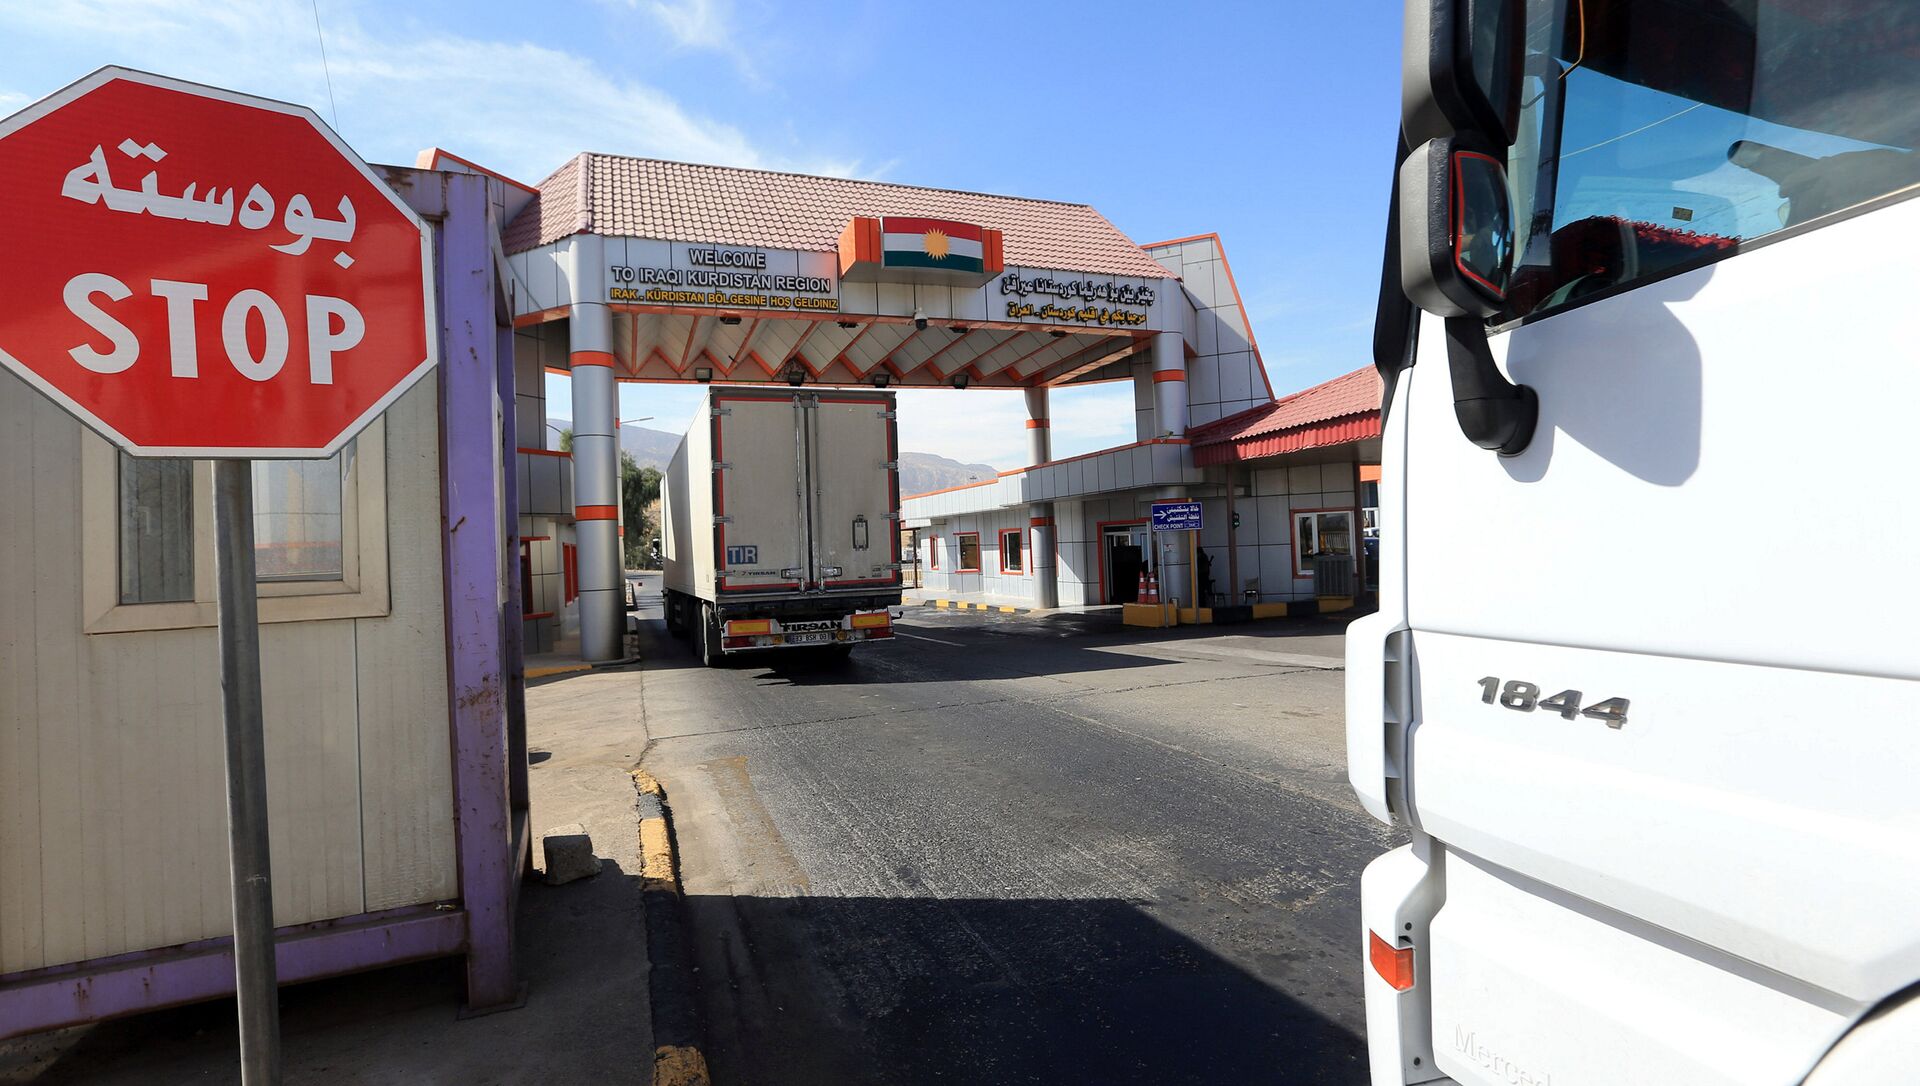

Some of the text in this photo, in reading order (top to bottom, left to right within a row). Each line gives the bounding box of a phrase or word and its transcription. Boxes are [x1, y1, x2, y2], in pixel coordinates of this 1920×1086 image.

[689, 247, 766, 269] WELCOME
[611, 266, 831, 293] TO IRAQI KURDISTAN REGION
[610, 287, 637, 300] IRAK
[707, 290, 767, 307] BÖLGESINE
[769, 295, 791, 309] HOŞ
[62, 272, 366, 385] STOP
[729, 547, 757, 563] TIR
[780, 621, 842, 632] TIRSAN
[1477, 676, 1631, 730] 1844
